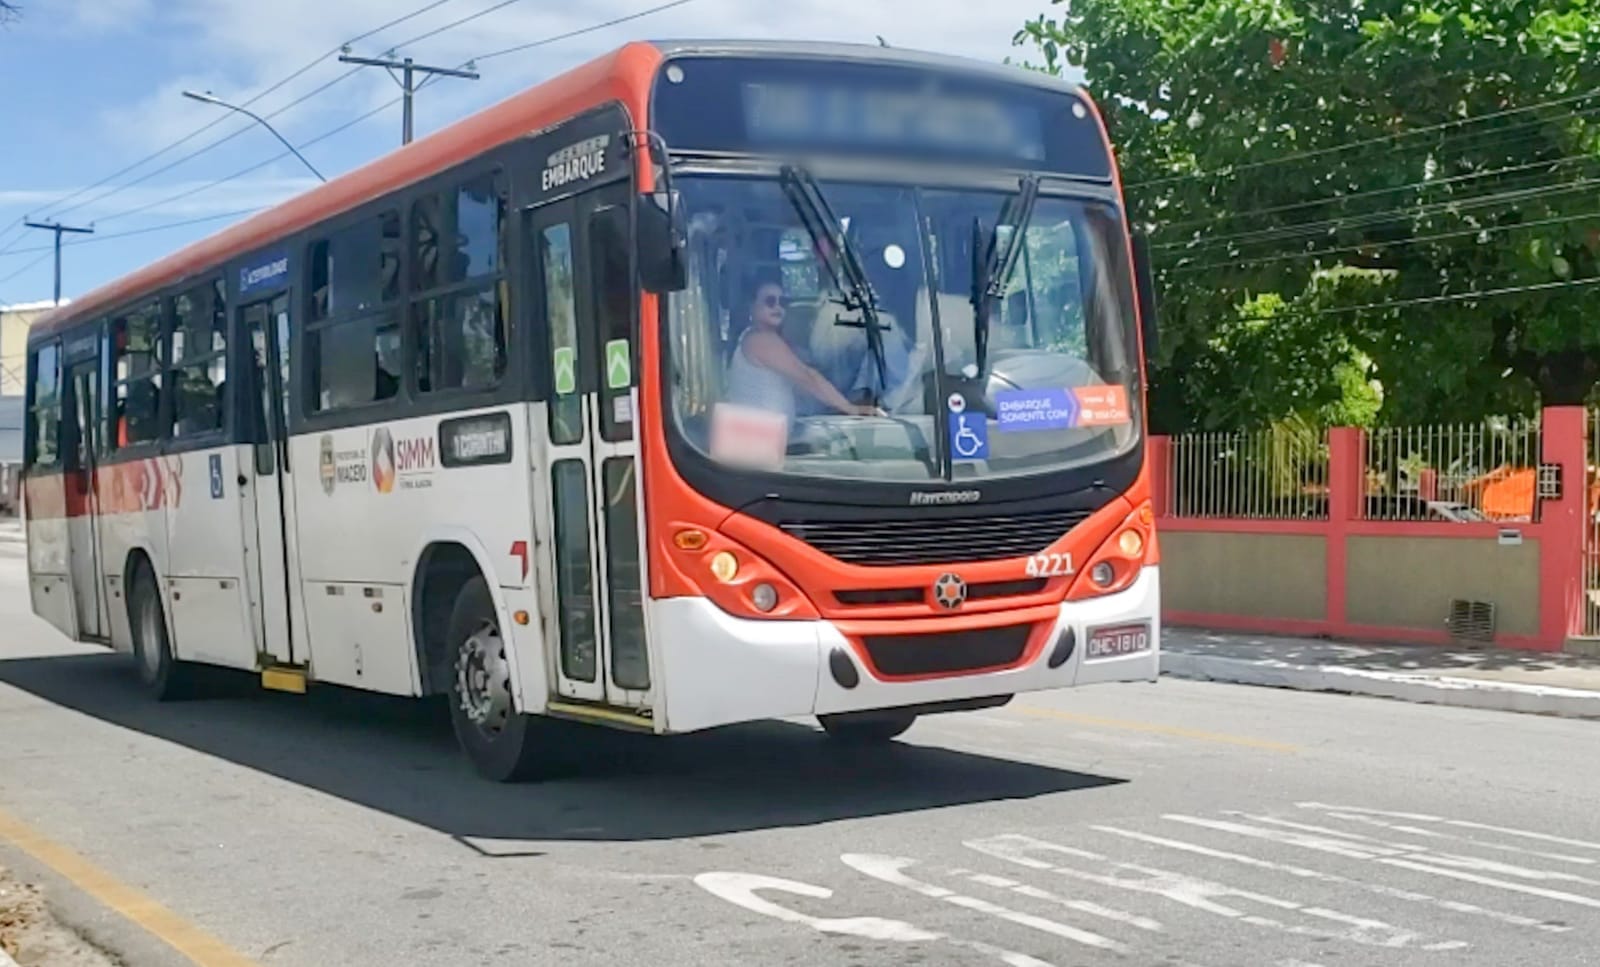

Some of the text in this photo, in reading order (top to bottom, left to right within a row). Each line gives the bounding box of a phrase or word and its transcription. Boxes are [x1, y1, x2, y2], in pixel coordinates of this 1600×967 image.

[542, 149, 605, 191] EMBARQUE
[1000, 397, 1051, 412] EMBARQUE
[1001, 410, 1045, 423] SOMENTE
[1046, 408, 1069, 420] COM
[397, 437, 435, 469] SIMM
[1025, 551, 1075, 578] 4221
